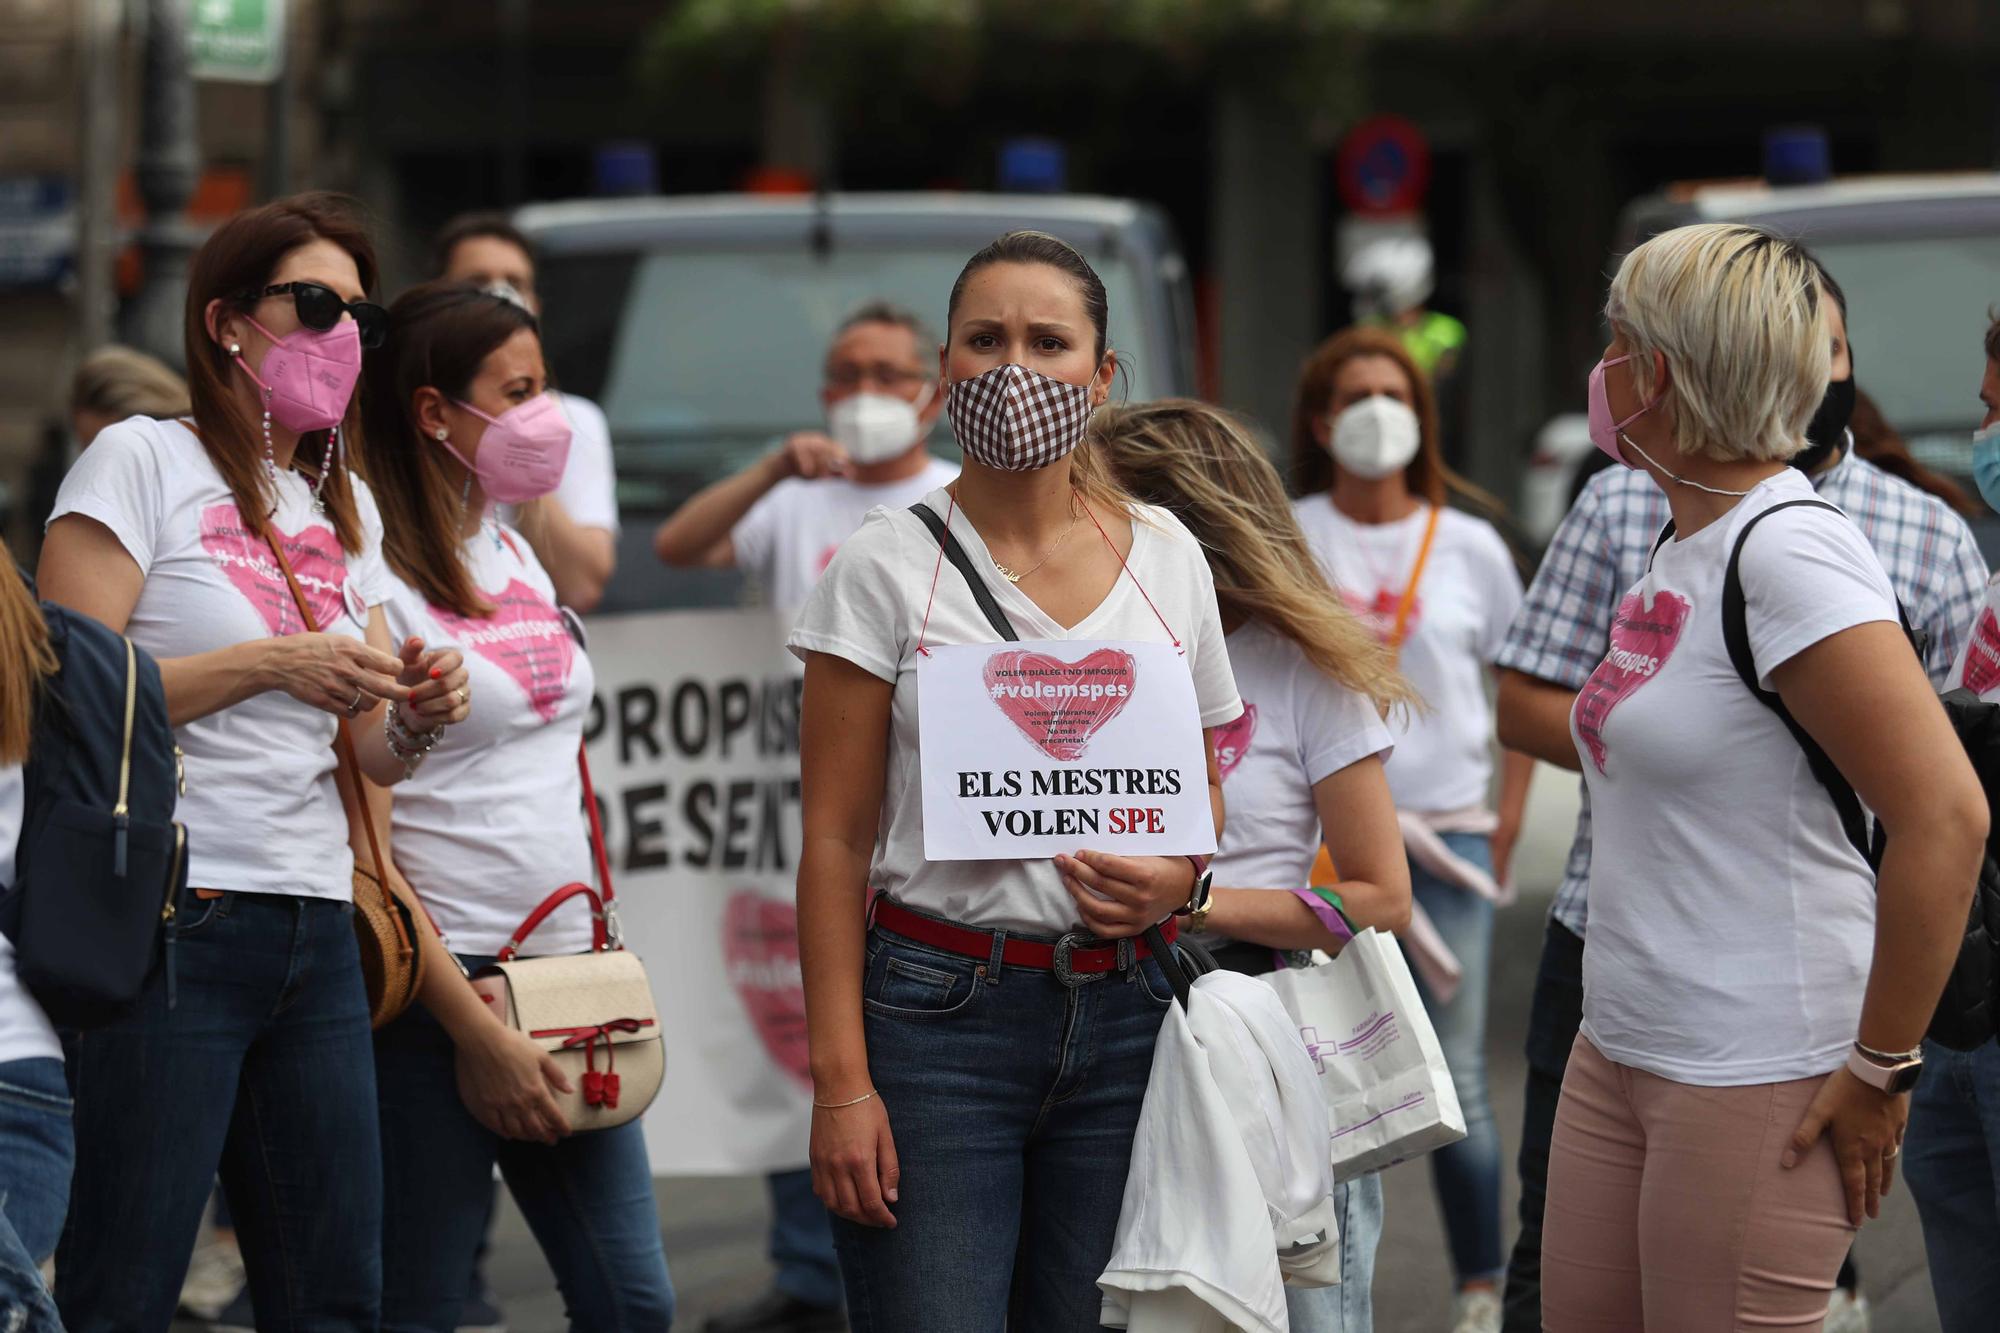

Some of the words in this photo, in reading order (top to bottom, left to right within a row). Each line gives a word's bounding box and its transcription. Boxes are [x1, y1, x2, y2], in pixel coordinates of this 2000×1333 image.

[995, 669, 1026, 677] VOLEM
[1068, 668, 1082, 676] NO
[1085, 666, 1128, 676] IMPOSICIÓ
[991, 681, 1129, 701] #volemspes
[957, 770, 1022, 798] ELS
[1030, 768, 1182, 796] MESTRES
[981, 808, 1099, 837] VOLEN
[1108, 807, 1166, 835] SPE
